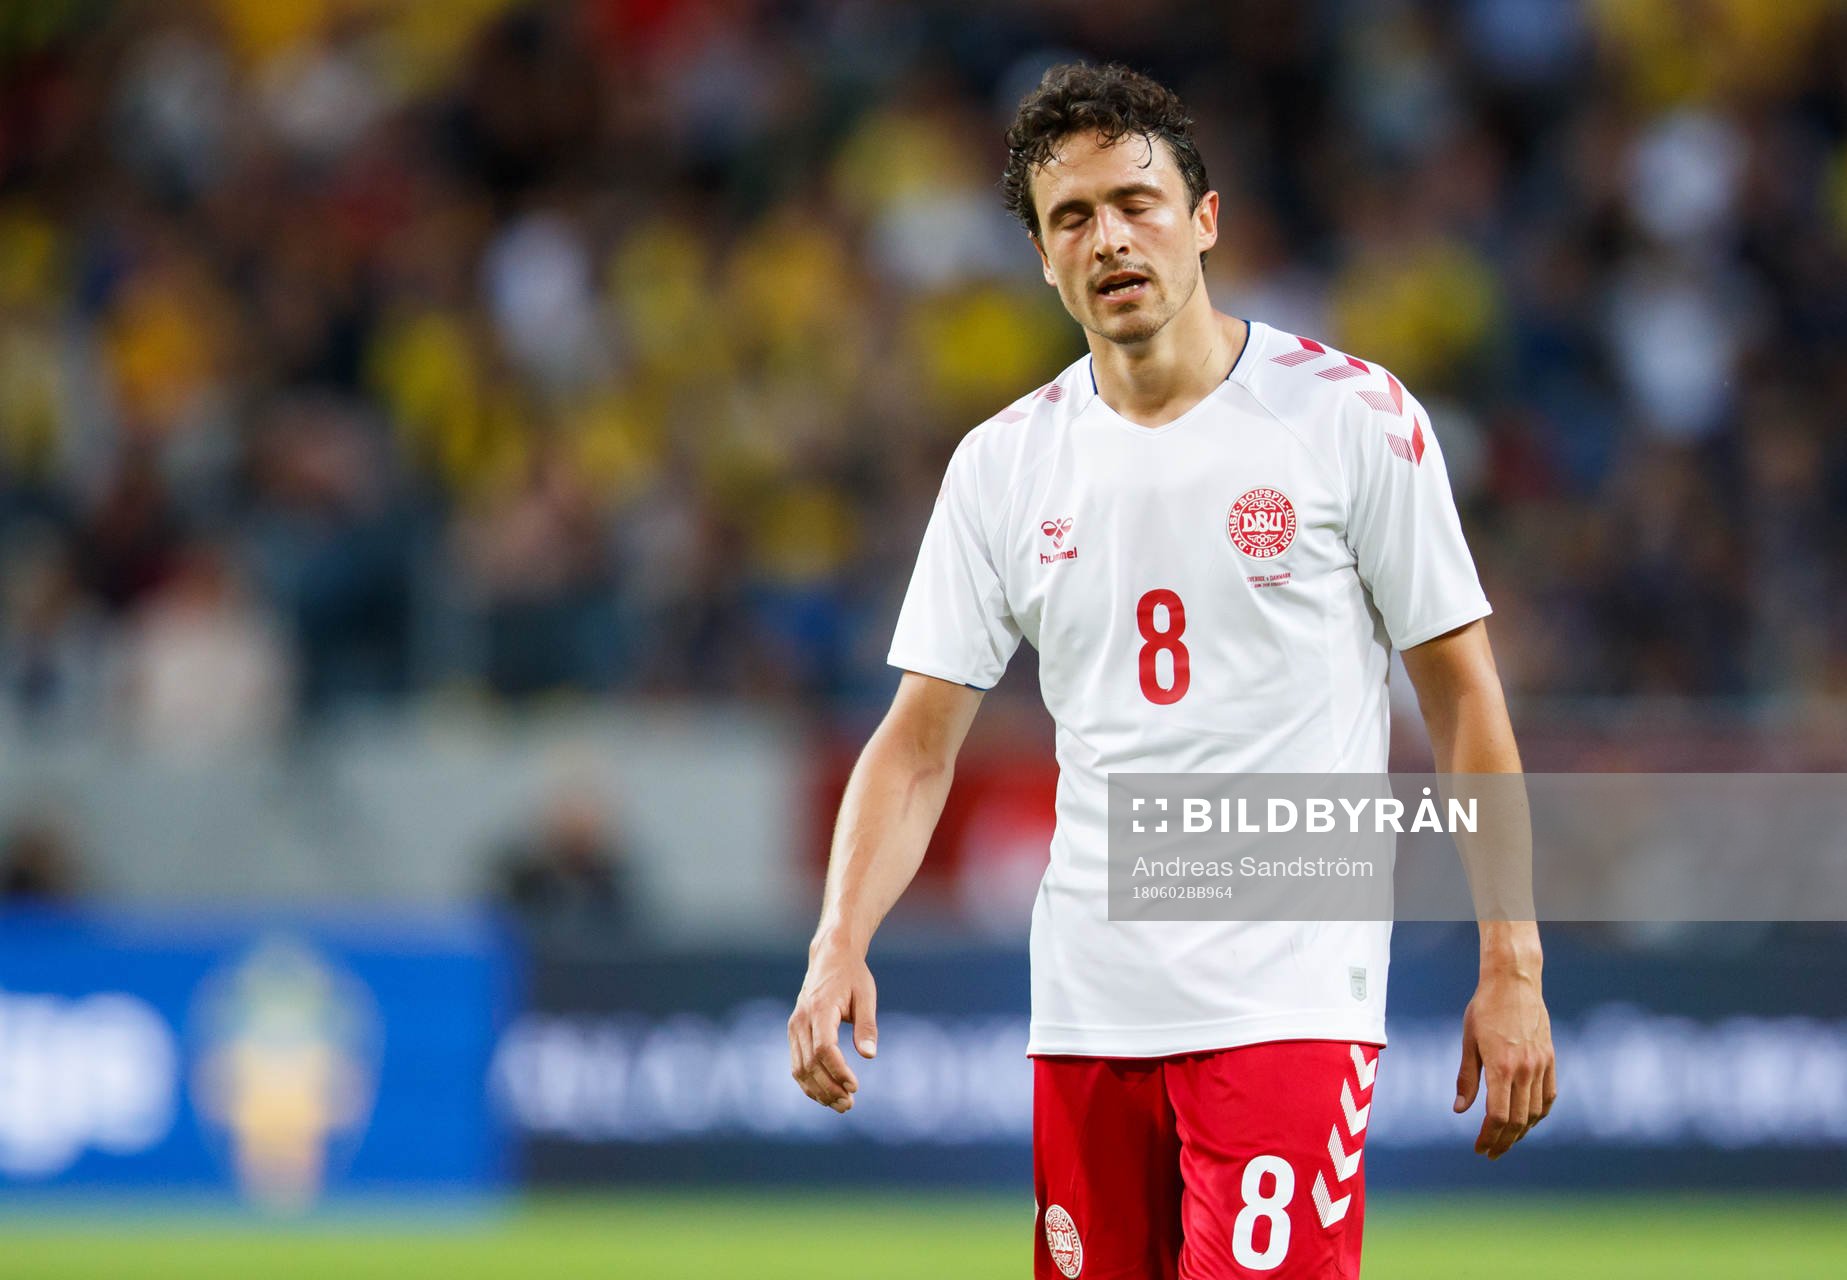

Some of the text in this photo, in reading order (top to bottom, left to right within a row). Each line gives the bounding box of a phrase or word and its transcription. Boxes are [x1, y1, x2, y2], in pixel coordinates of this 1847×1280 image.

[1229, 508, 1248, 550] DANSK
[1241, 510, 1284, 533] DBU
[1040, 546, 1078, 565] hummel
[1249, 546, 1279, 557] 1889
[1136, 588, 1191, 706] 8
[1231, 1154, 1296, 1271] 8
